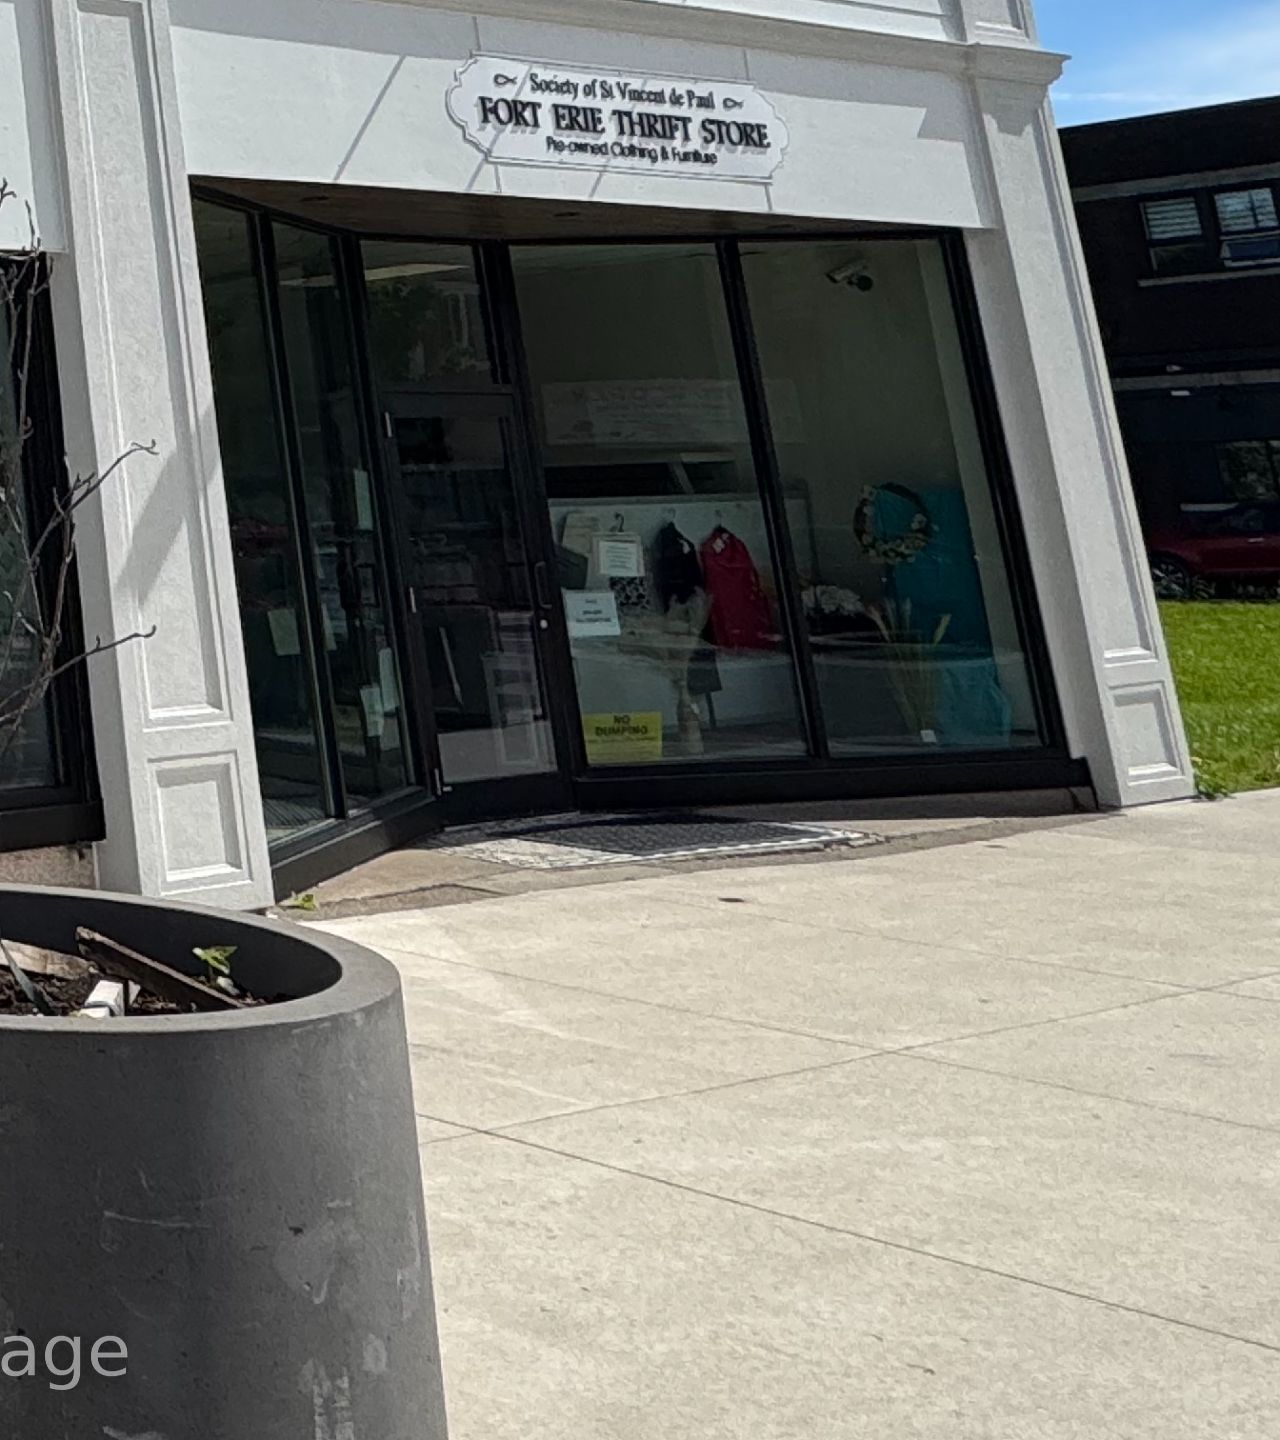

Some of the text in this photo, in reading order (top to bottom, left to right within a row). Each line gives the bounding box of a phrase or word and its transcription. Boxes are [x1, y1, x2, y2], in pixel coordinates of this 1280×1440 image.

[529, 72, 716, 109] Society of St Vincent de Paul
[478, 96, 771, 148] FORT ERIE THRIFT STORE
[545, 136, 609, 157] Pre-owned
[610, 141, 658, 164] Clothing
[660, 145, 669, 161] &
[595, 725, 648, 736] DUMPING
[613, 715, 631, 724] NO
